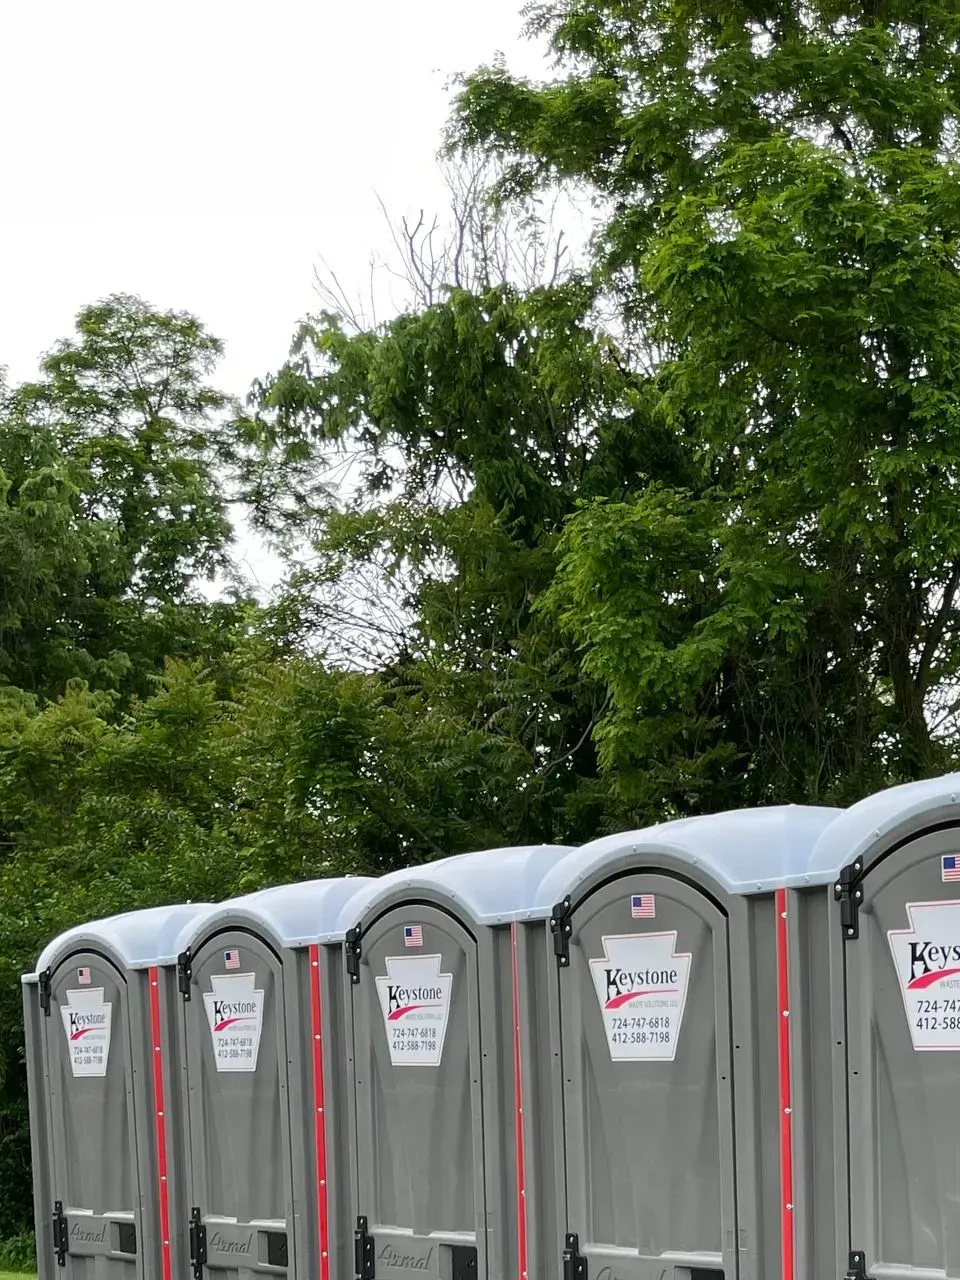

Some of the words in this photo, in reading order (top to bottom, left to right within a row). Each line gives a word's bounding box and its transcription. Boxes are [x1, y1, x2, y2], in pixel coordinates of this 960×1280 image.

[604, 968, 678, 1005] Keystone
[940, 979, 960, 989] WASTE
[387, 985, 442, 1016] Keystone
[213, 1000, 257, 1027] Keystone
[69, 1012, 106, 1037] Keystone
[612, 1017, 670, 1029] 724-747-6818
[392, 1028, 436, 1038] 724-747-6818
[612, 1032, 670, 1044] 412-588-7198
[392, 1041, 436, 1051] 412-588-7198
[377, 1244, 434, 1273] Armal
